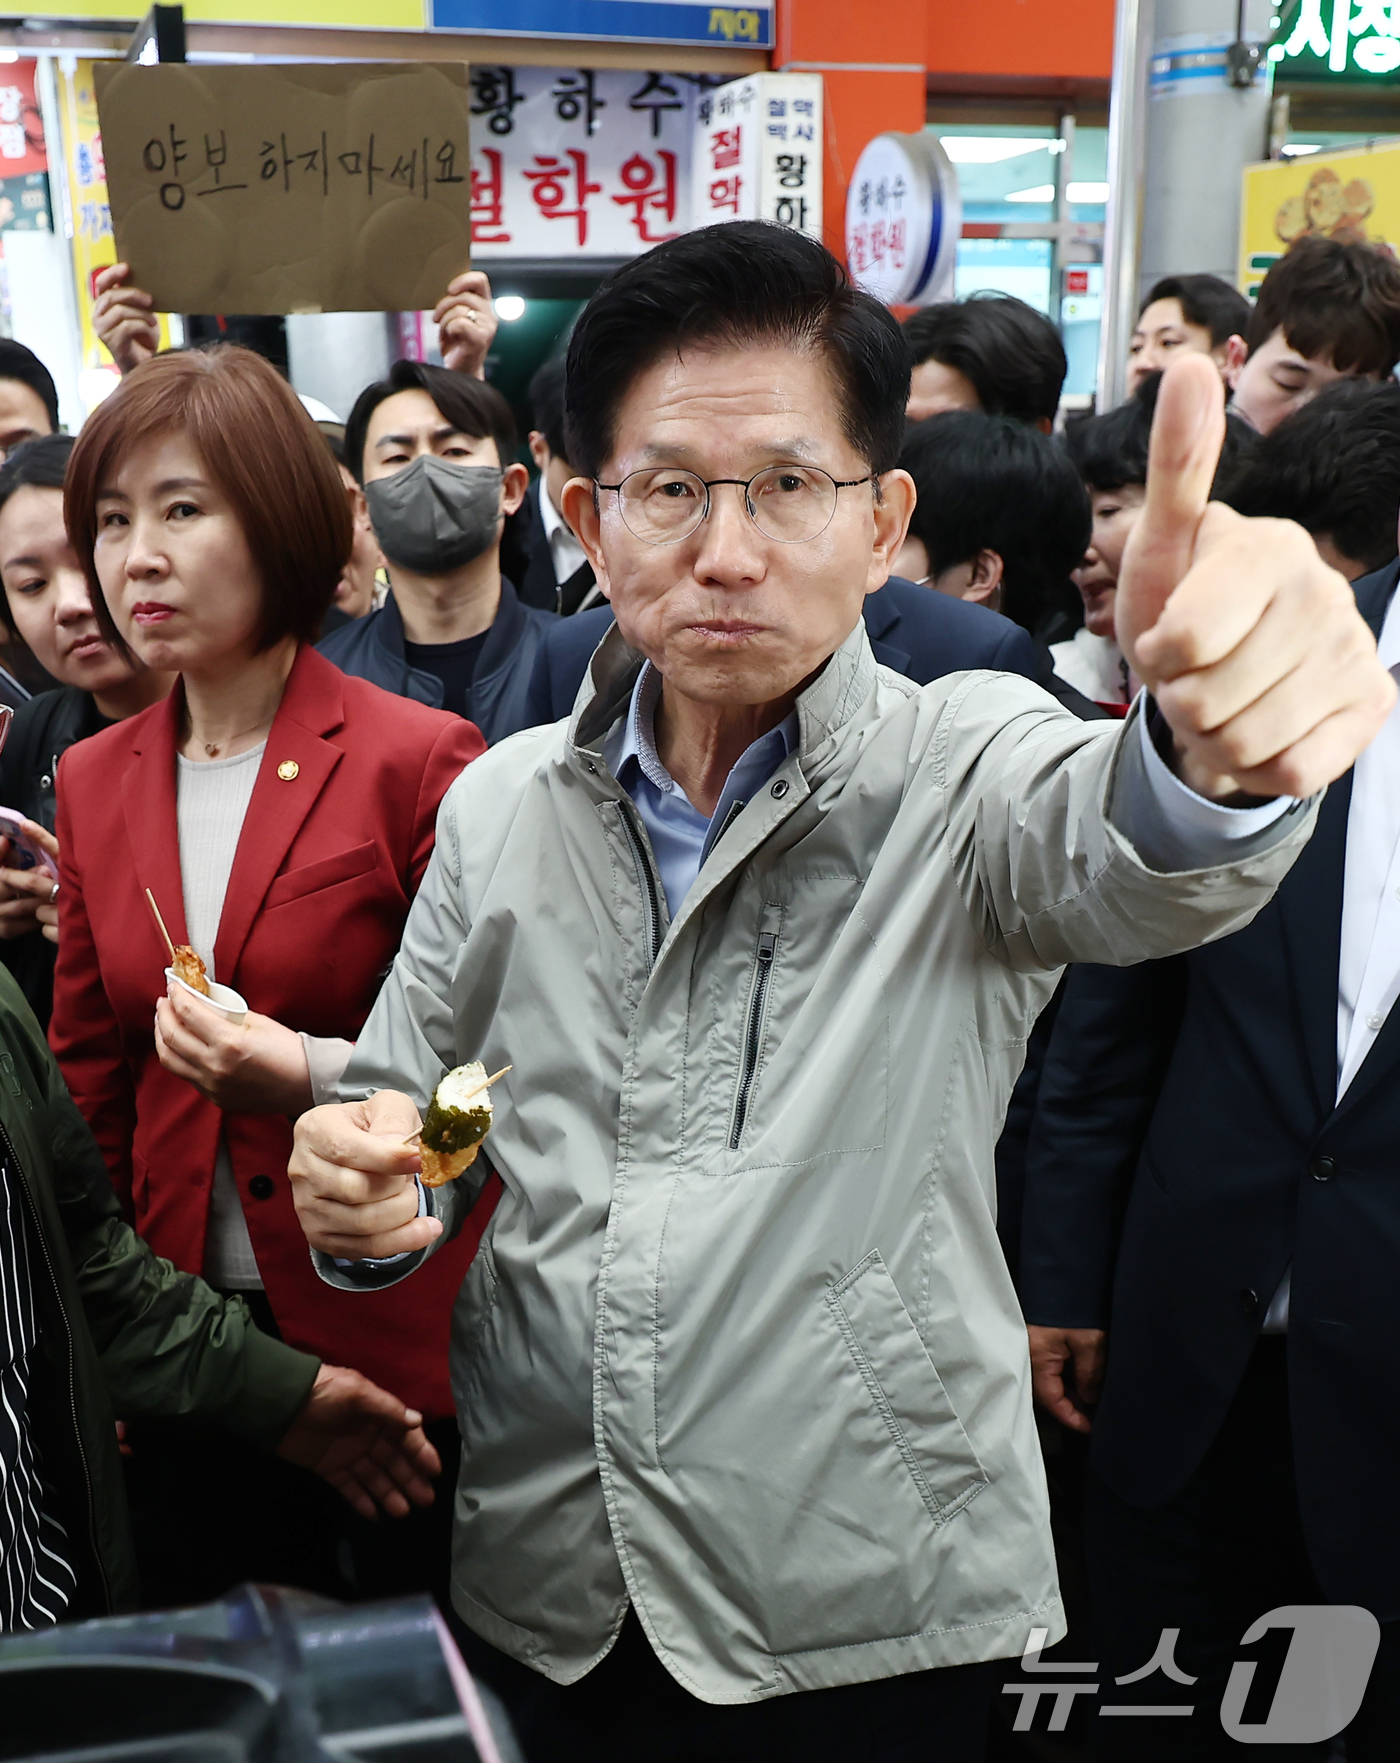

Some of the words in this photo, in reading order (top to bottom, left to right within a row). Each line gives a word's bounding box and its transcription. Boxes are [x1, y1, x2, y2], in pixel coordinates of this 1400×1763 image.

[470, 67, 683, 137] 황하수
[143, 124, 247, 210] 양보
[260, 131, 464, 200] 하지마세요
